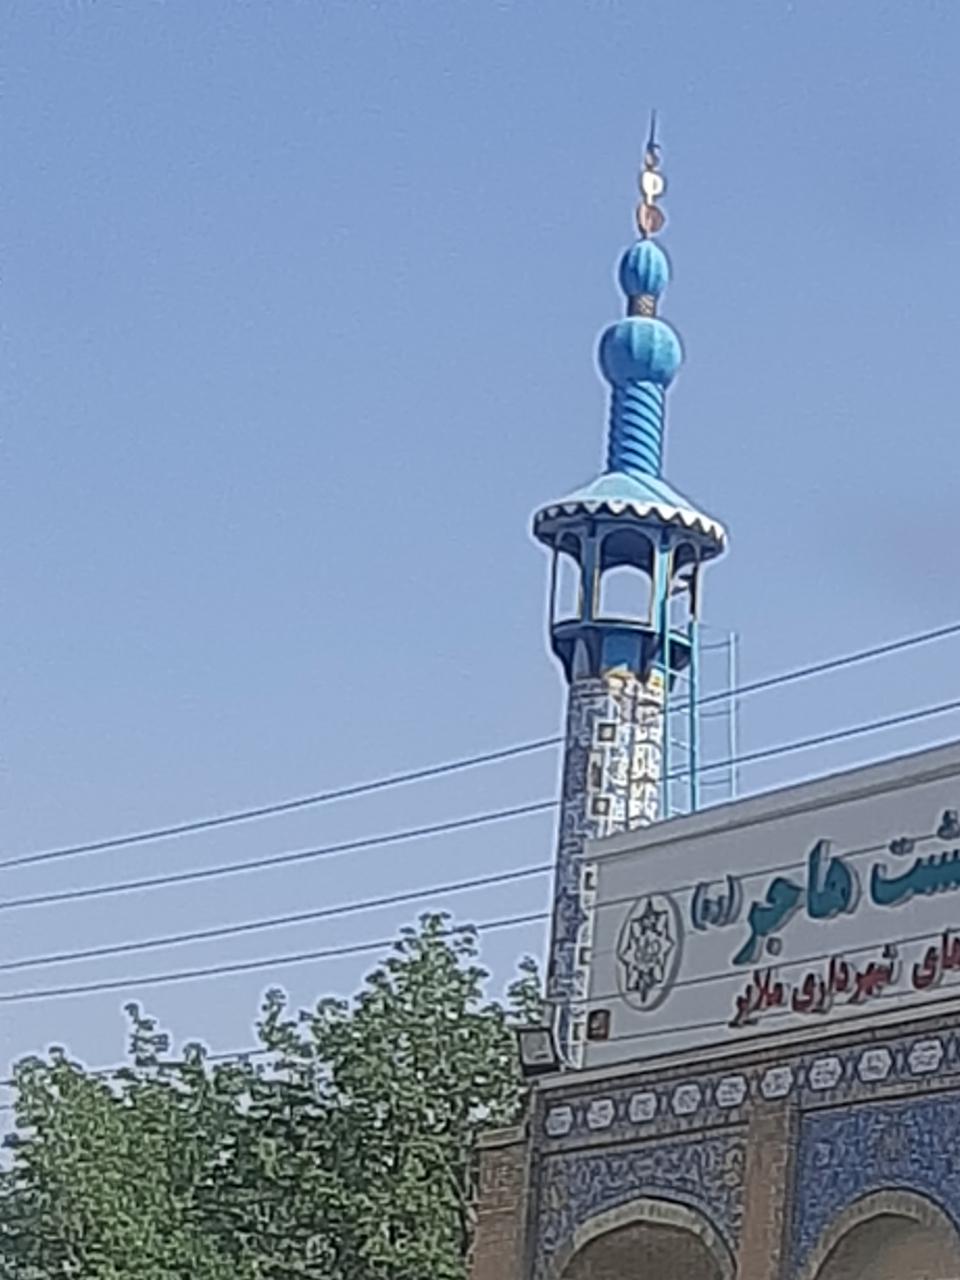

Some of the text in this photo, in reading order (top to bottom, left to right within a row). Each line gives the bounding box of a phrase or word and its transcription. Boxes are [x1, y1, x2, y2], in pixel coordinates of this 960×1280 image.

[732, 838, 861, 965] هاجر
[728, 967, 788, 1028] ملایر
[792, 943, 901, 1015] شهرداری
